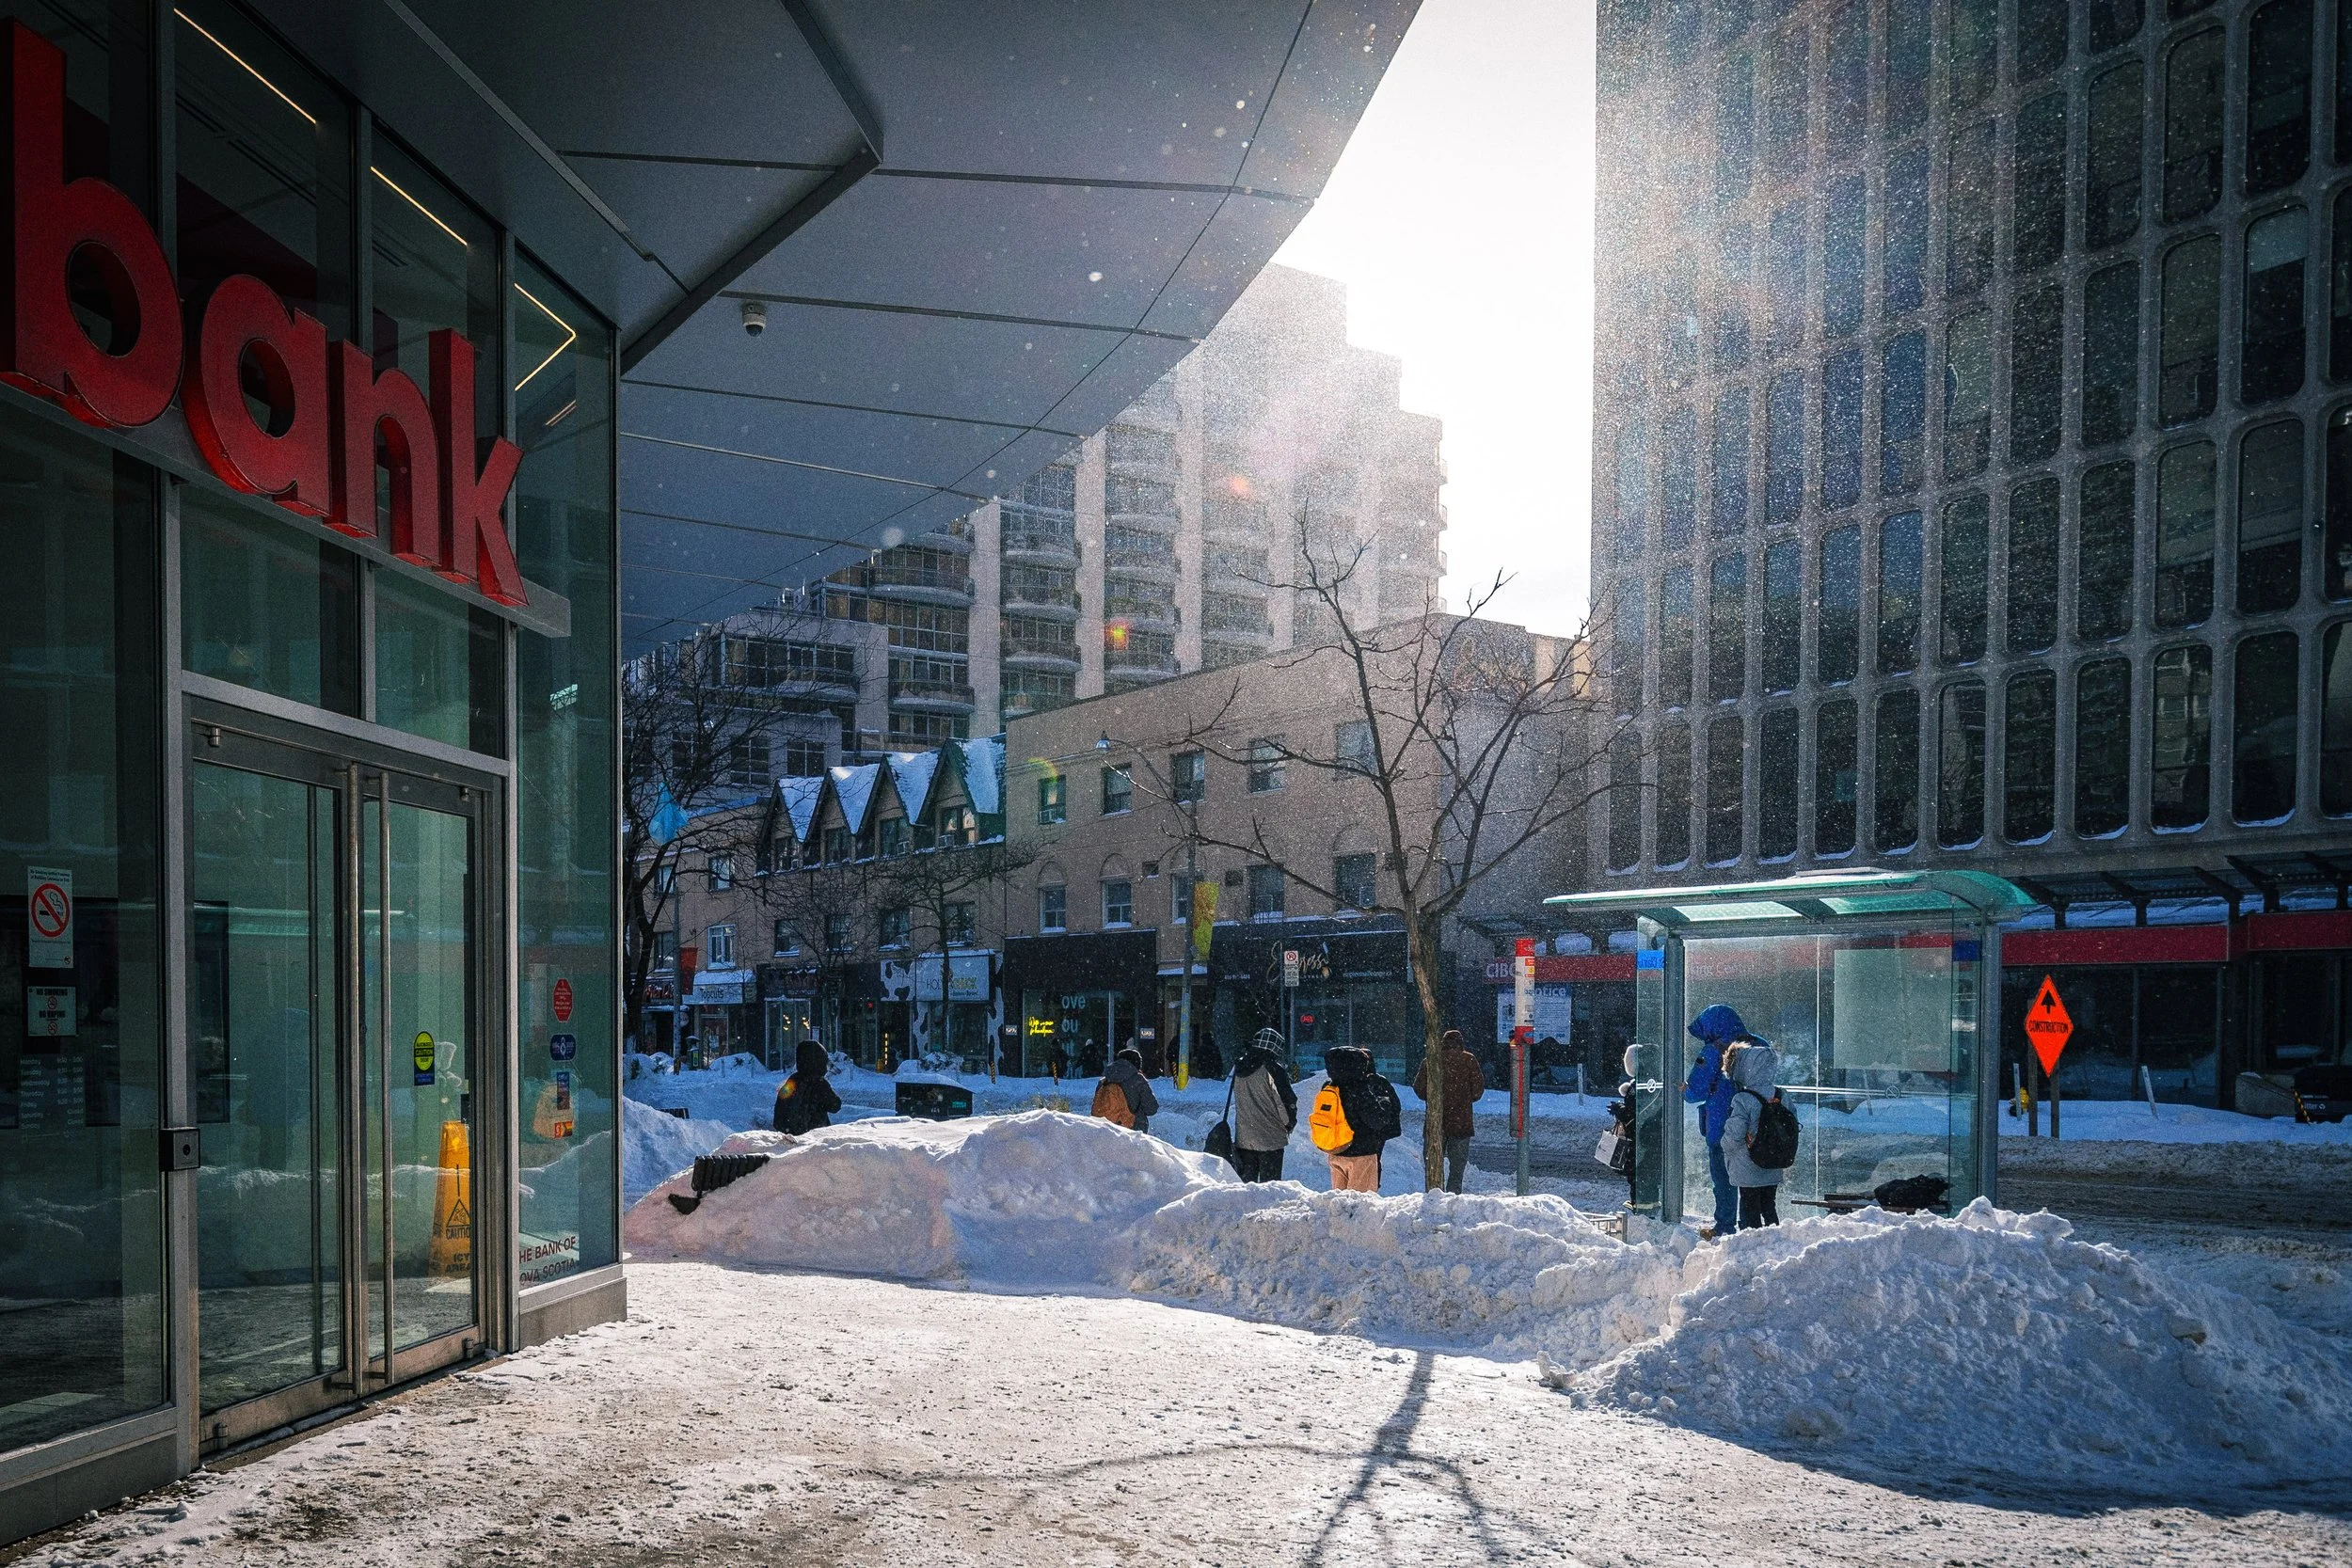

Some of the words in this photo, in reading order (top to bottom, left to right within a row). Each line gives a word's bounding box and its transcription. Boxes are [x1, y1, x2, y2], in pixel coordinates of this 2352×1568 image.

[2, 16, 529, 607] bank
[1534, 987, 1565, 996] otice
[2028, 1021, 2069, 1034] CONSTRUCTION
[519, 1248, 532, 1264] HE
[534, 1240, 562, 1259] BANK
[564, 1236, 576, 1251] OF
[519, 1269, 540, 1283] OVA
[543, 1258, 576, 1279] SCOTIA
